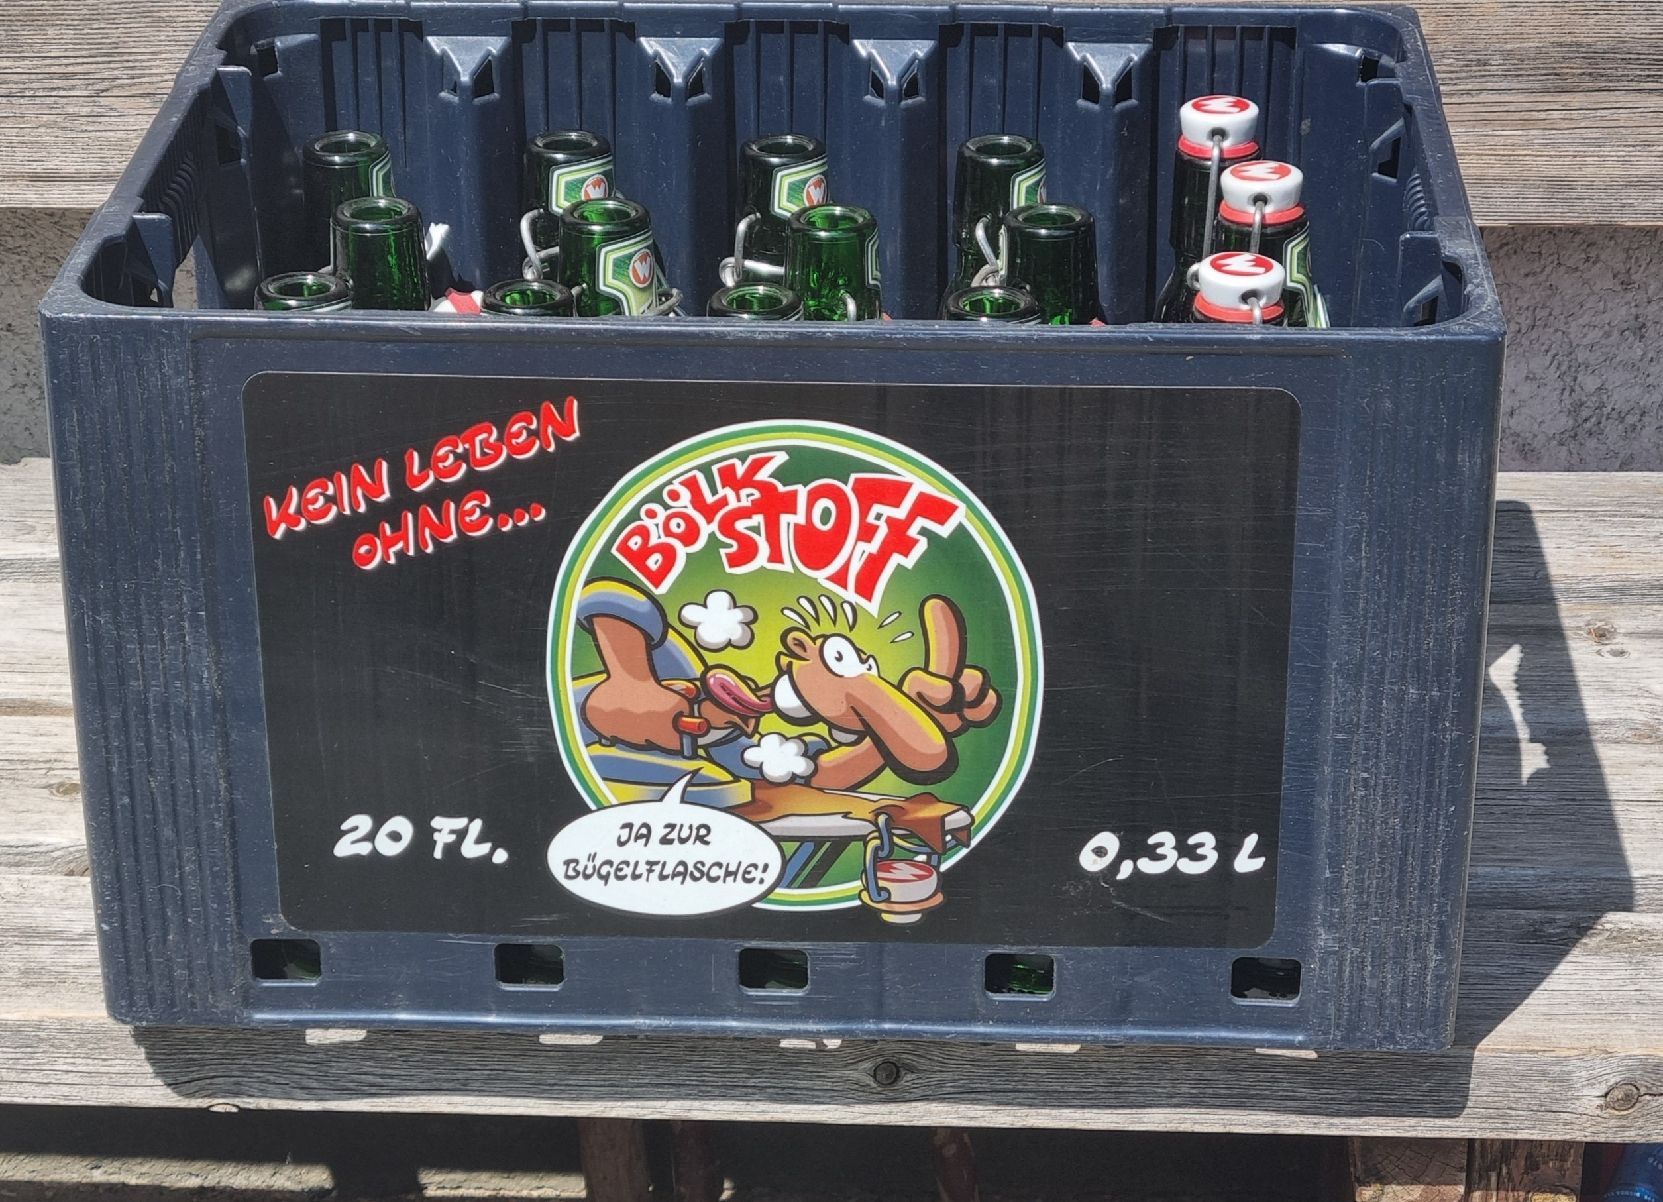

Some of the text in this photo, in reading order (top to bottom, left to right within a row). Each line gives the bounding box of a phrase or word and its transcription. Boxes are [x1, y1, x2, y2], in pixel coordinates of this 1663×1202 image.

[263, 395, 580, 540] KEIN LEBEN
[351, 489, 546, 570] OHNE...
[611, 450, 790, 595] BÖLK
[714, 472, 967, 618] STOFF
[332, 813, 510, 865] 20 FL.
[615, 821, 712, 847] JA ZUR
[1078, 830, 1219, 881] 0,33
[562, 854, 770, 886] BÜGELFLASCHE!
